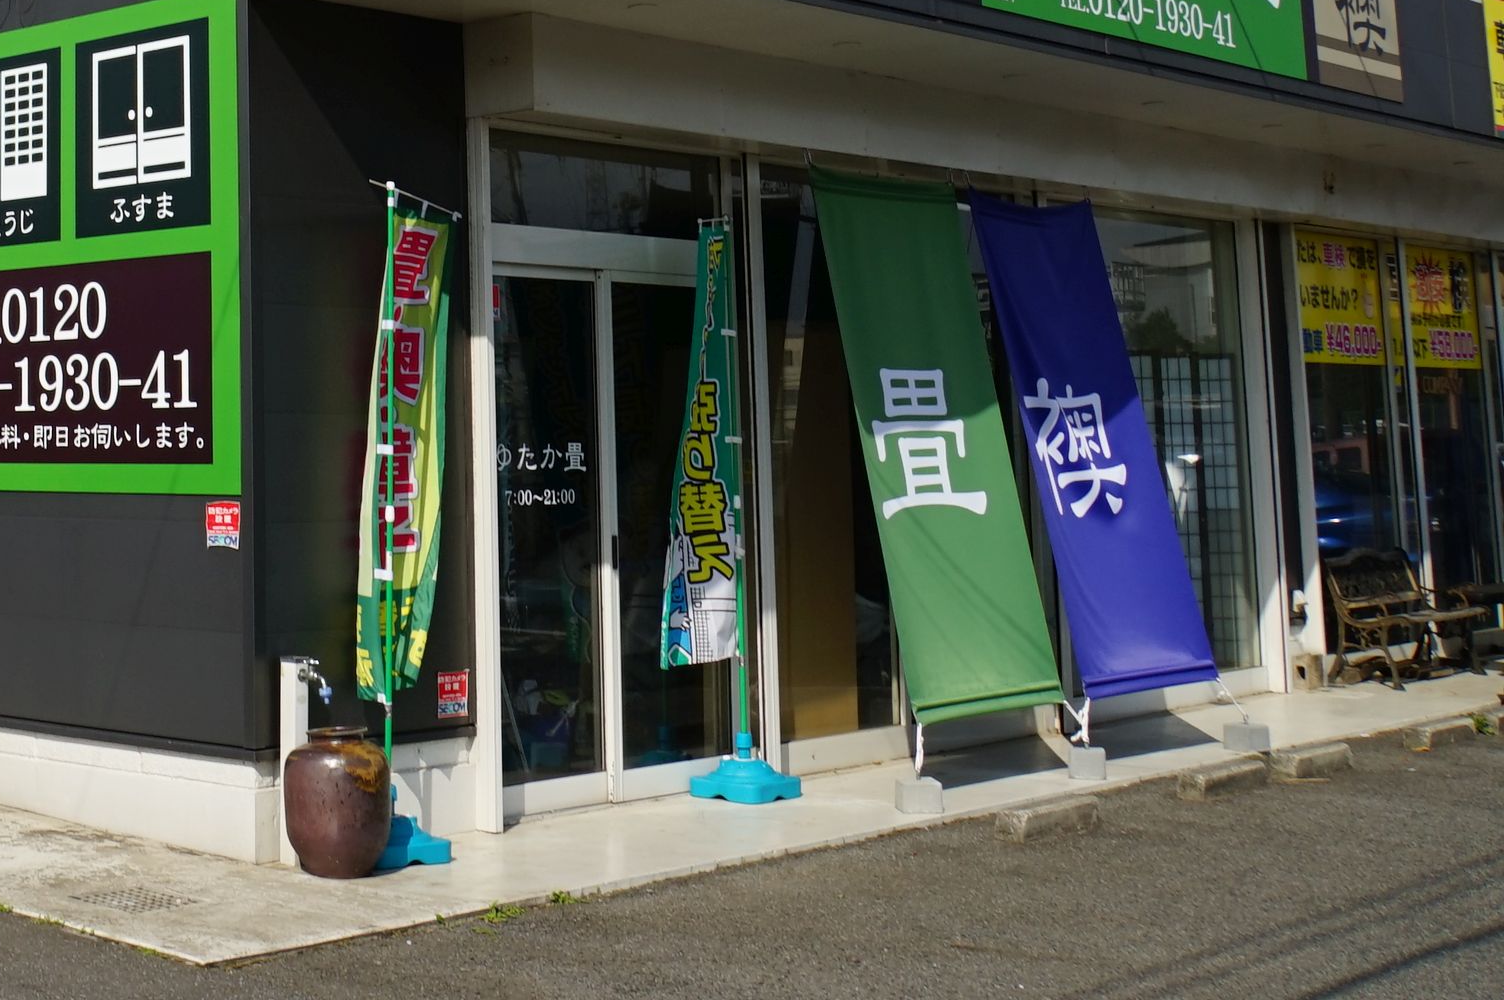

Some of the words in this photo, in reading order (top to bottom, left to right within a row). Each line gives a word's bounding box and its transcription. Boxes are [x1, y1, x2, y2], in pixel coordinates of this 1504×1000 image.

[110, 191, 174, 223] ふすま
[872, 367, 987, 520] 畳
[1023, 377, 1127, 519] 襖
